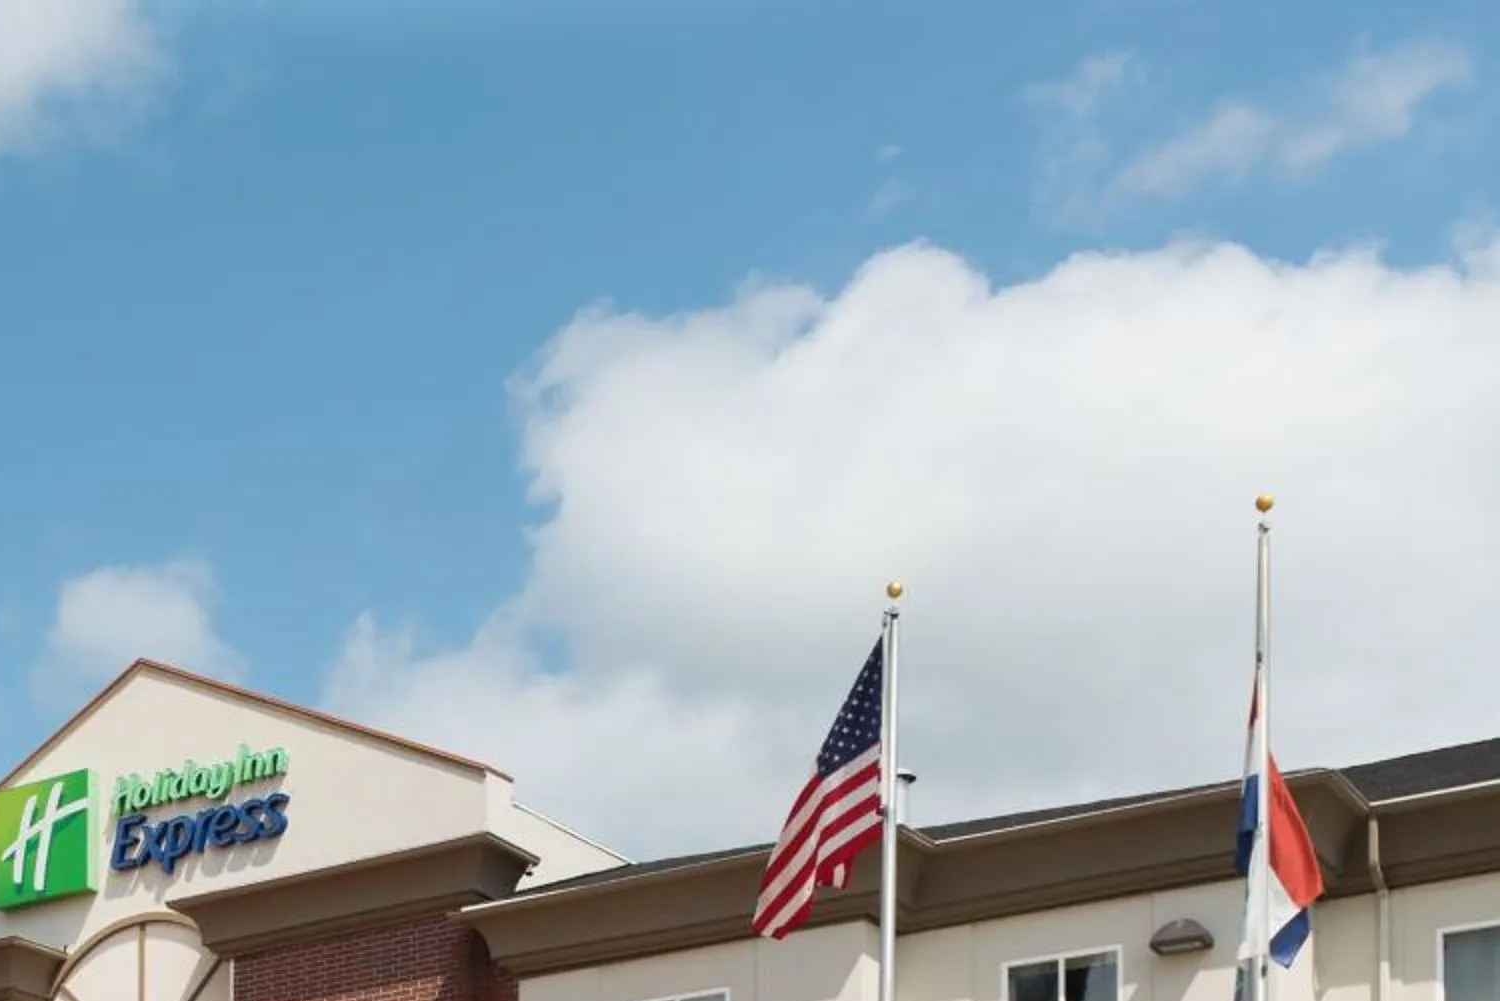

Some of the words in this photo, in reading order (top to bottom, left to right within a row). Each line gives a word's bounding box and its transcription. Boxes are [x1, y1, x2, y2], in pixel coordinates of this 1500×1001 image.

[112, 757, 235, 818] Holiday
[233, 743, 289, 785] Inn
[2, 781, 88, 892] H
[110, 793, 290, 874] Express
